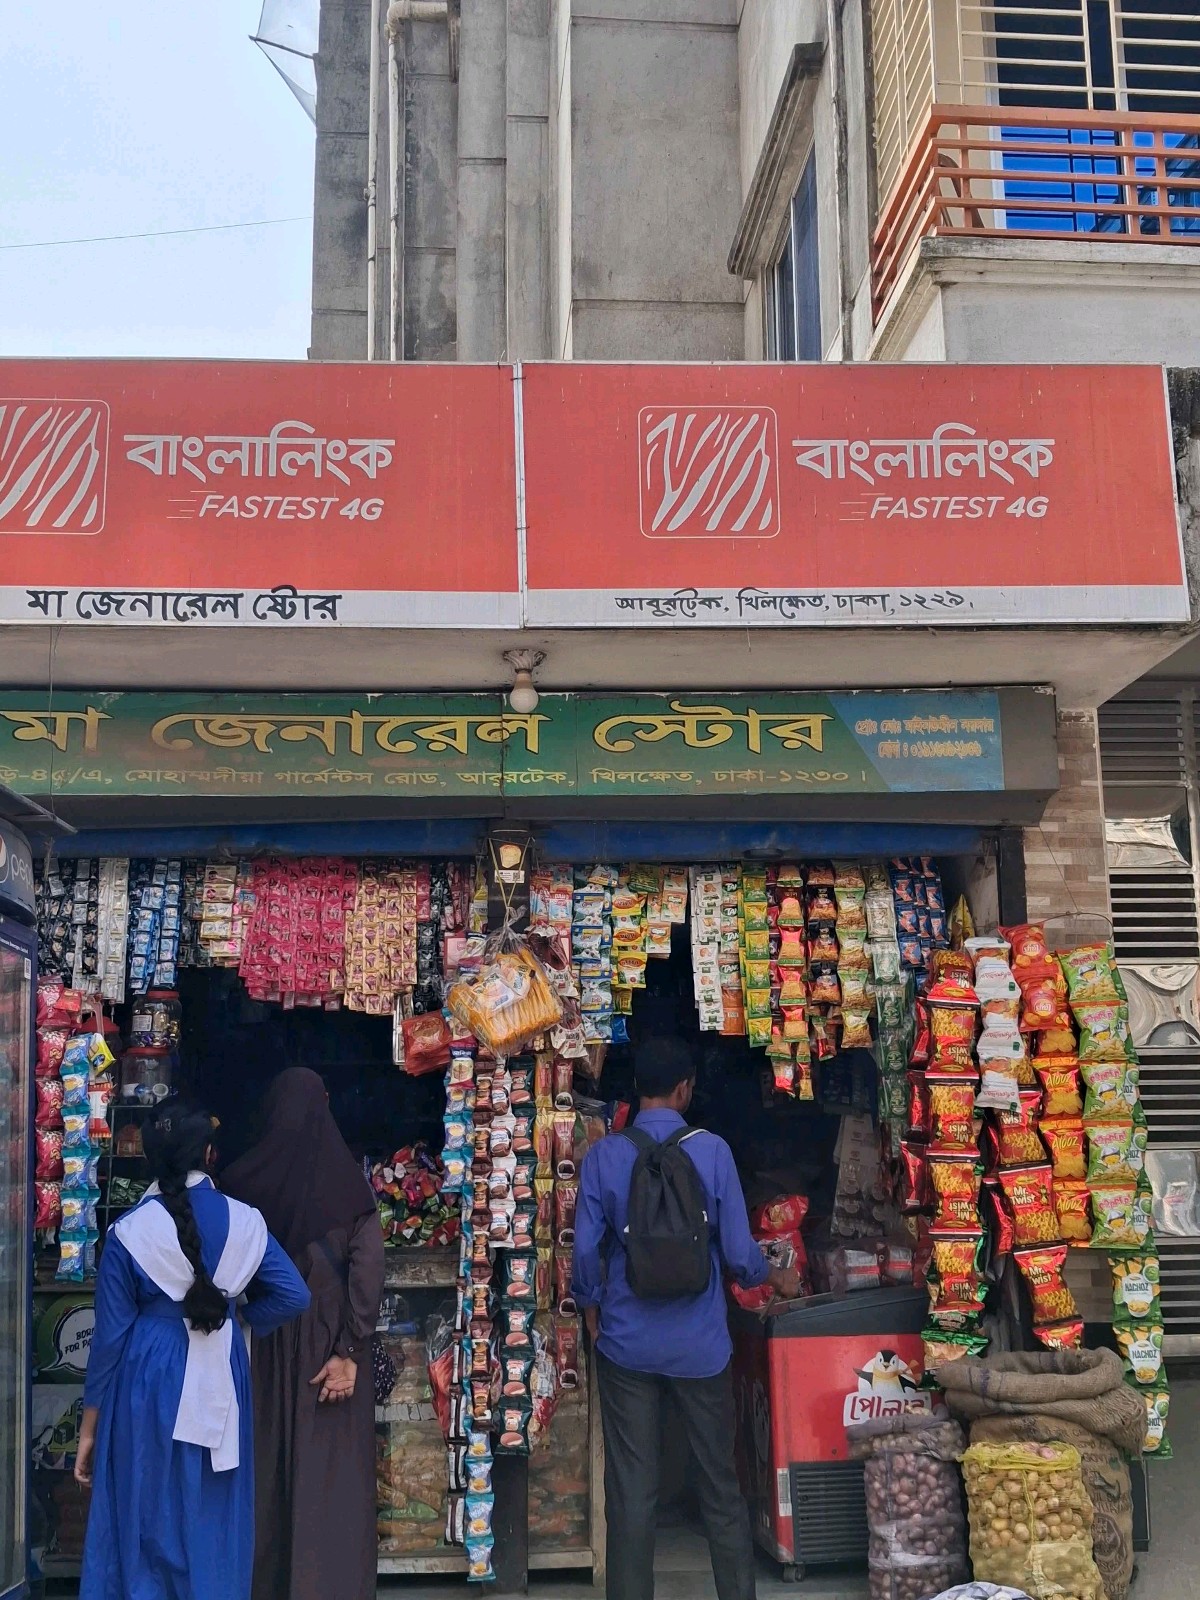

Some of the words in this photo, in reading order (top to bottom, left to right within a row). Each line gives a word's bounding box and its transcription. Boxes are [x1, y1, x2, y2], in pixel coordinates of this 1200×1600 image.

[124, 420, 395, 486] বাংলালিংক
[792, 422, 1055, 486] বাংলালিংক
[199, 495, 339, 519] FASTEST
[340, 498, 384, 520] 4G
[870, 496, 1004, 519] FASTEST
[1006, 496, 1049, 518] 4G
[26, 590, 68, 618] মা
[76, 590, 244, 622] জেনারেল
[253, 584, 342, 621] ষ্টোর
[0, 705, 113, 752] মা
[151, 709, 553, 756] জেনারেল
[593, 700, 835, 754] স্টোর
[1010, 1193, 1035, 1206] Twist
[1124, 1282, 1149, 1292] NACHOZ
[65, 1343, 80, 1355] FOR
[1131, 1349, 1157, 1359] NACHOZ
